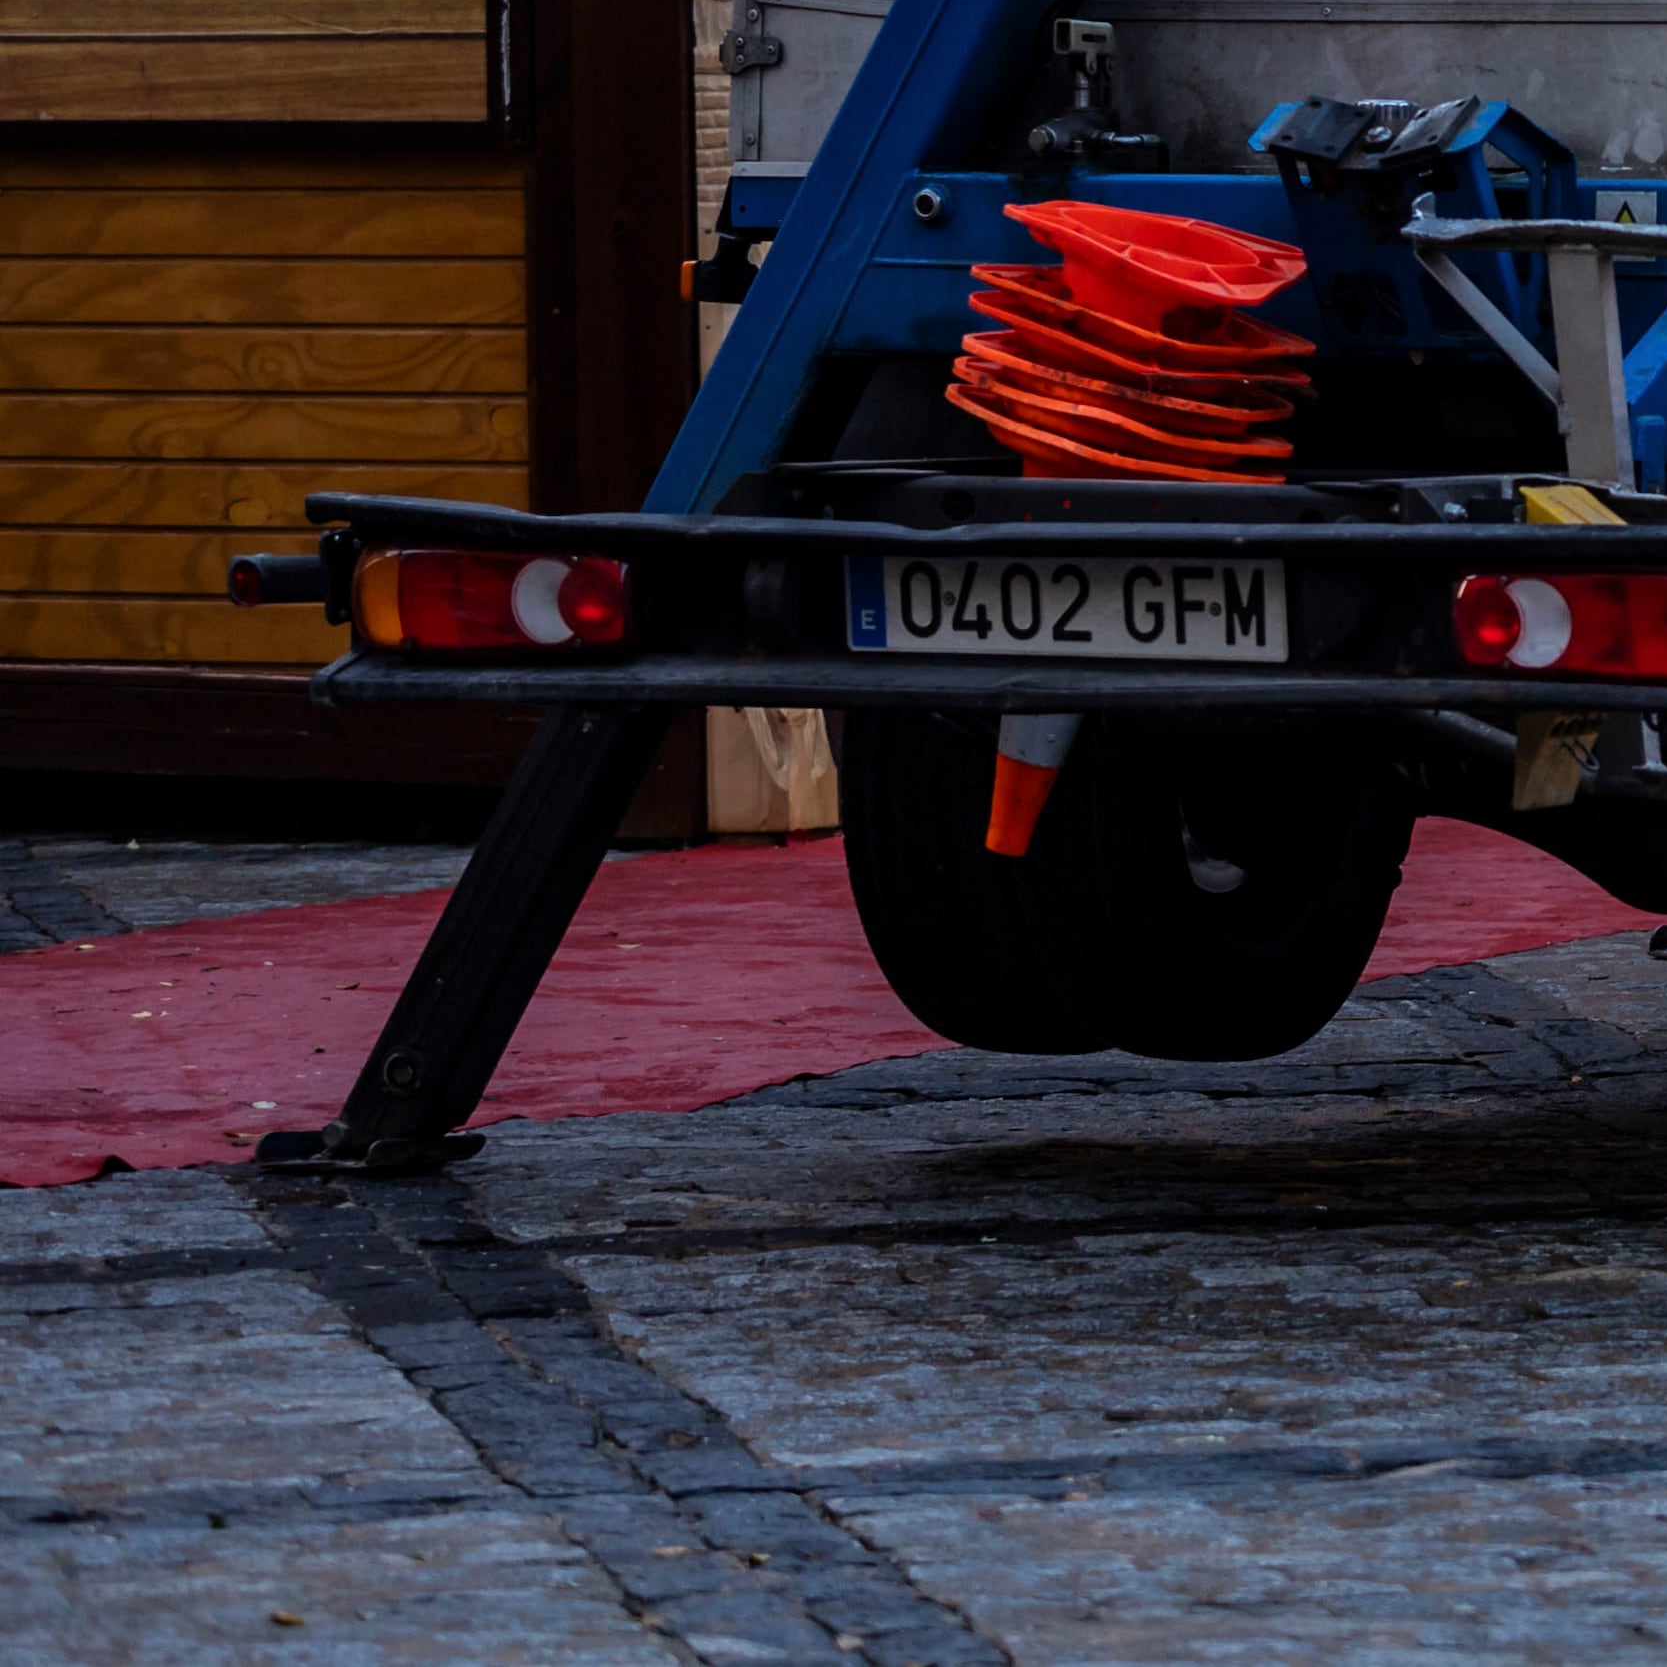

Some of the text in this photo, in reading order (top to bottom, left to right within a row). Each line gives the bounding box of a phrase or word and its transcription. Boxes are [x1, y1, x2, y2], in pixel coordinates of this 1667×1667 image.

[861, 560, 1267, 647] E 0402 GFM
